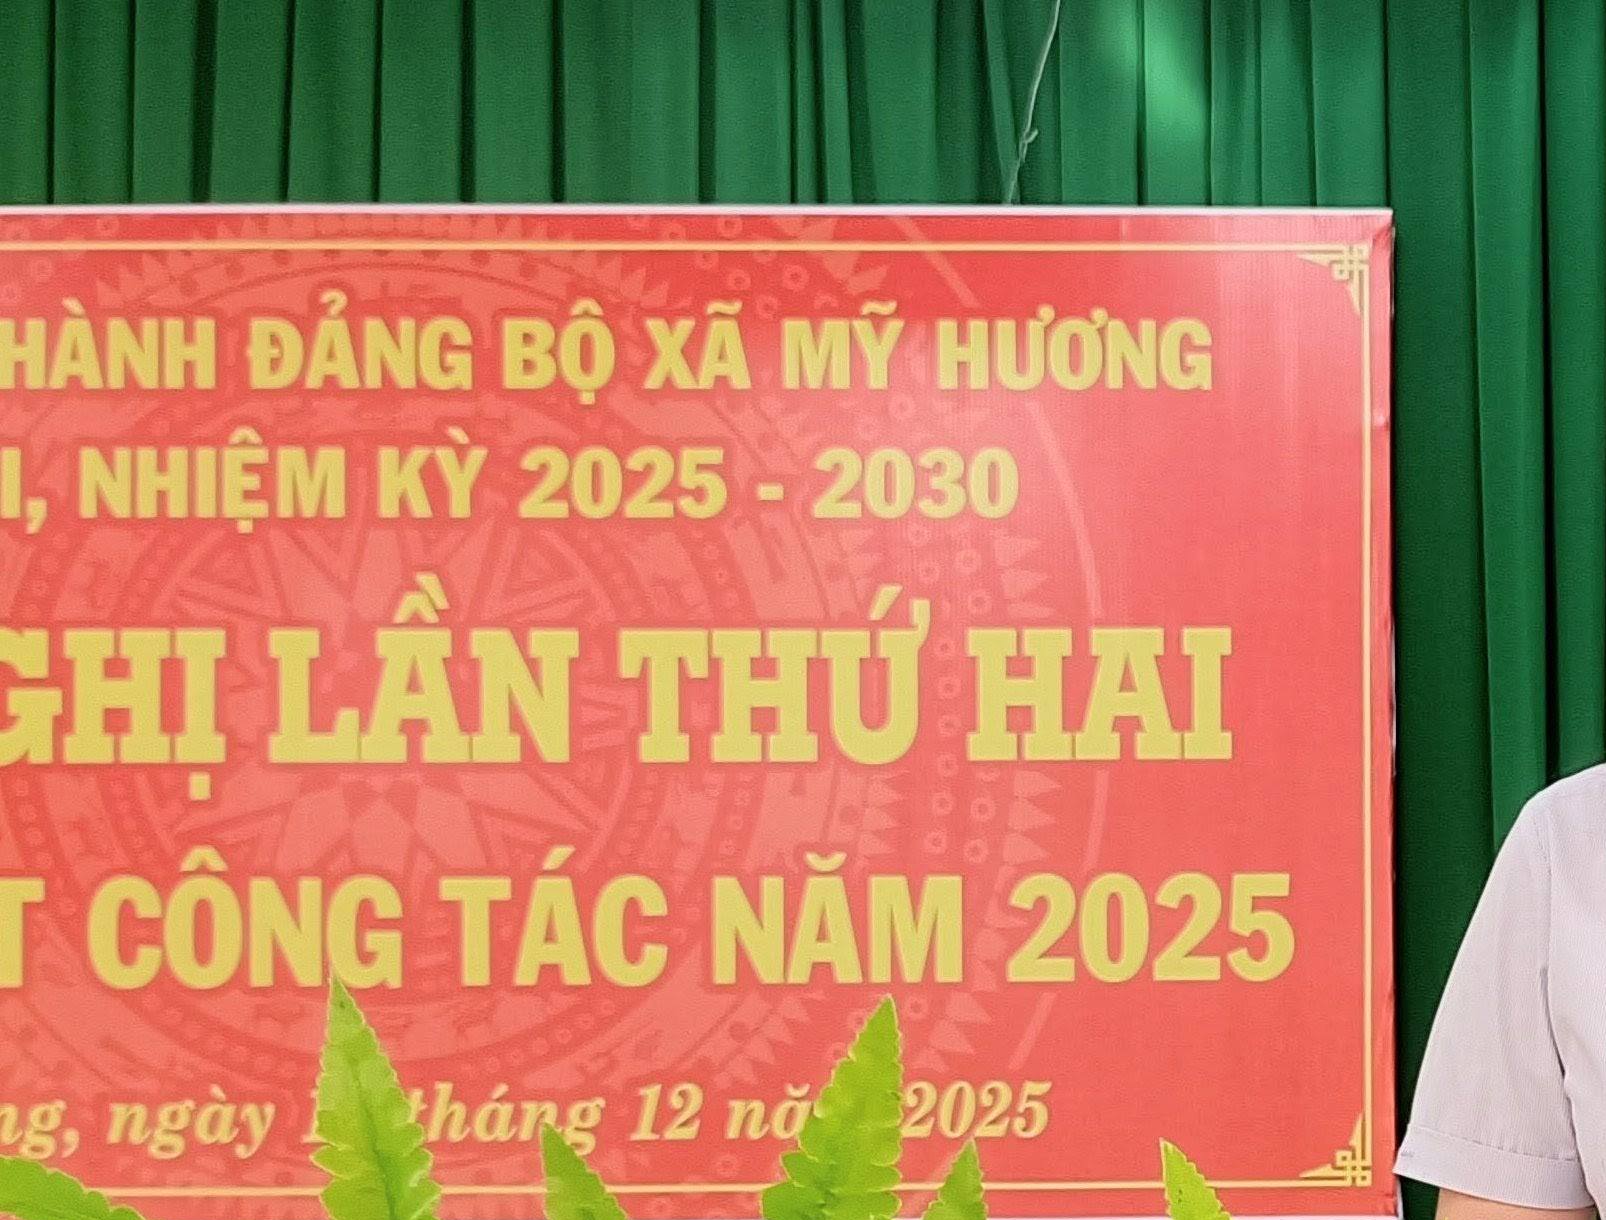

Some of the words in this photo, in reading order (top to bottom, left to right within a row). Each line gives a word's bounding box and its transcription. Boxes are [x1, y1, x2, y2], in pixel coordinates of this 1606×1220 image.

[0, 298, 216, 390] HÀNH
[247, 290, 473, 390] ĐẢNG
[503, 299, 615, 404] BỘ
[644, 300, 752, 390] XÃ
[781, 301, 904, 390] MỸ
[937, 304, 1212, 391] HƯƠNG
[80, 426, 346, 533] NHIỆM
[378, 426, 488, 519] KỲ
[519, 446, 728, 519] 2025
[757, 483, 784, 500] -
[812, 446, 1019, 519] 2030
[0, 627, 227, 800] GHỊ
[268, 572, 579, 763] LẦN
[618, 584, 931, 764] THỨ
[965, 626, 1233, 761] HAI
[88, 845, 403, 990] CÔNG
[439, 845, 669, 987] TÁC
[712, 851, 963, 985] NĂM
[1006, 871, 1294, 982] 2025
[107, 1083, 276, 1160] ngày
[630, 1082, 703, 1141] 12
[726, 1082, 815, 1140] nă
[903, 1079, 1052, 1139] 2025
